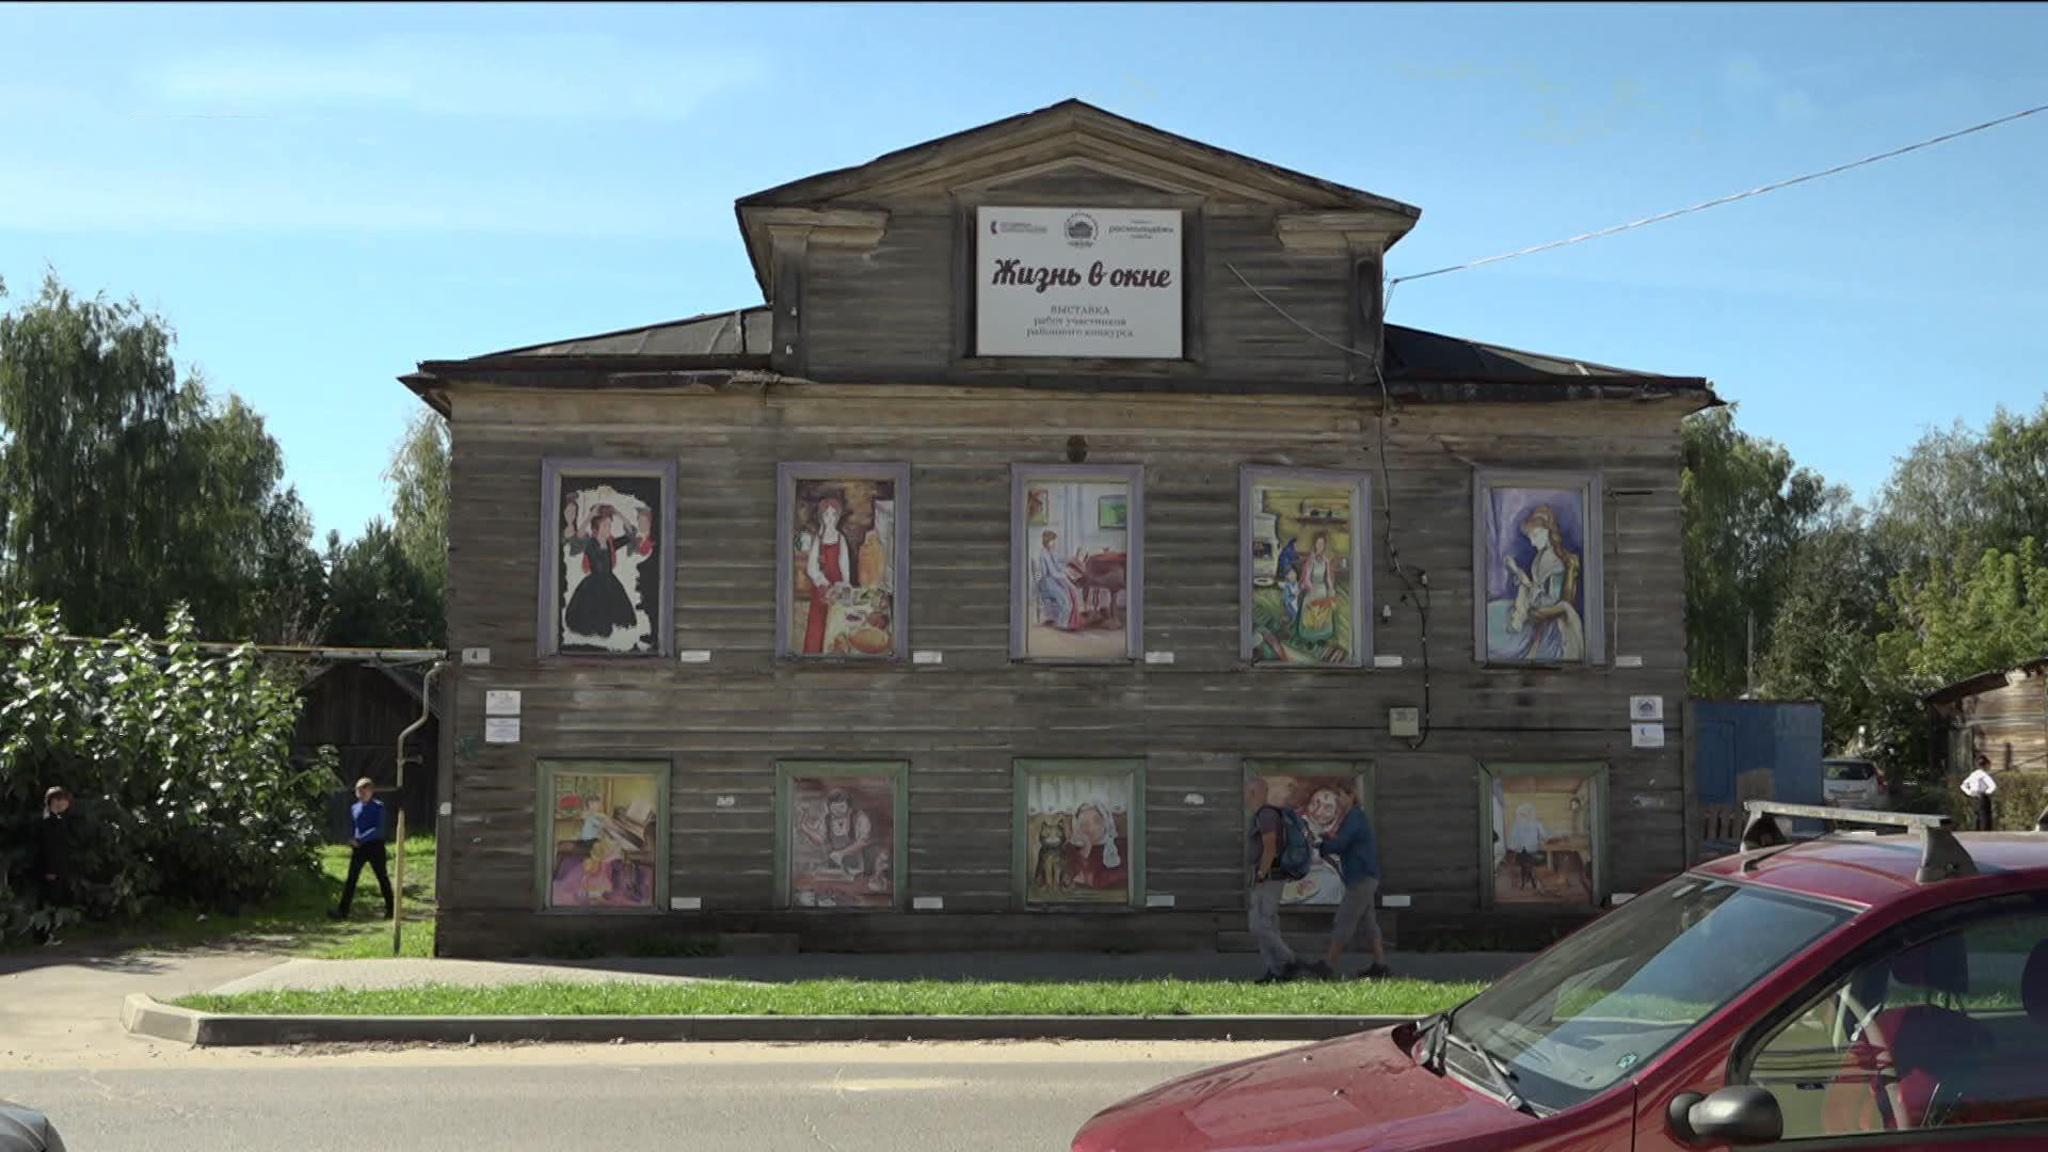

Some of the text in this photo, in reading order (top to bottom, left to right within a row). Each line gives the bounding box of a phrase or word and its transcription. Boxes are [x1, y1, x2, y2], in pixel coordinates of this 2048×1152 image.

[992, 259, 1171, 294] Жизнь в окне
[1051, 305, 1110, 316] ВЫСТАВКА
[1033, 316, 1063, 326] работ
